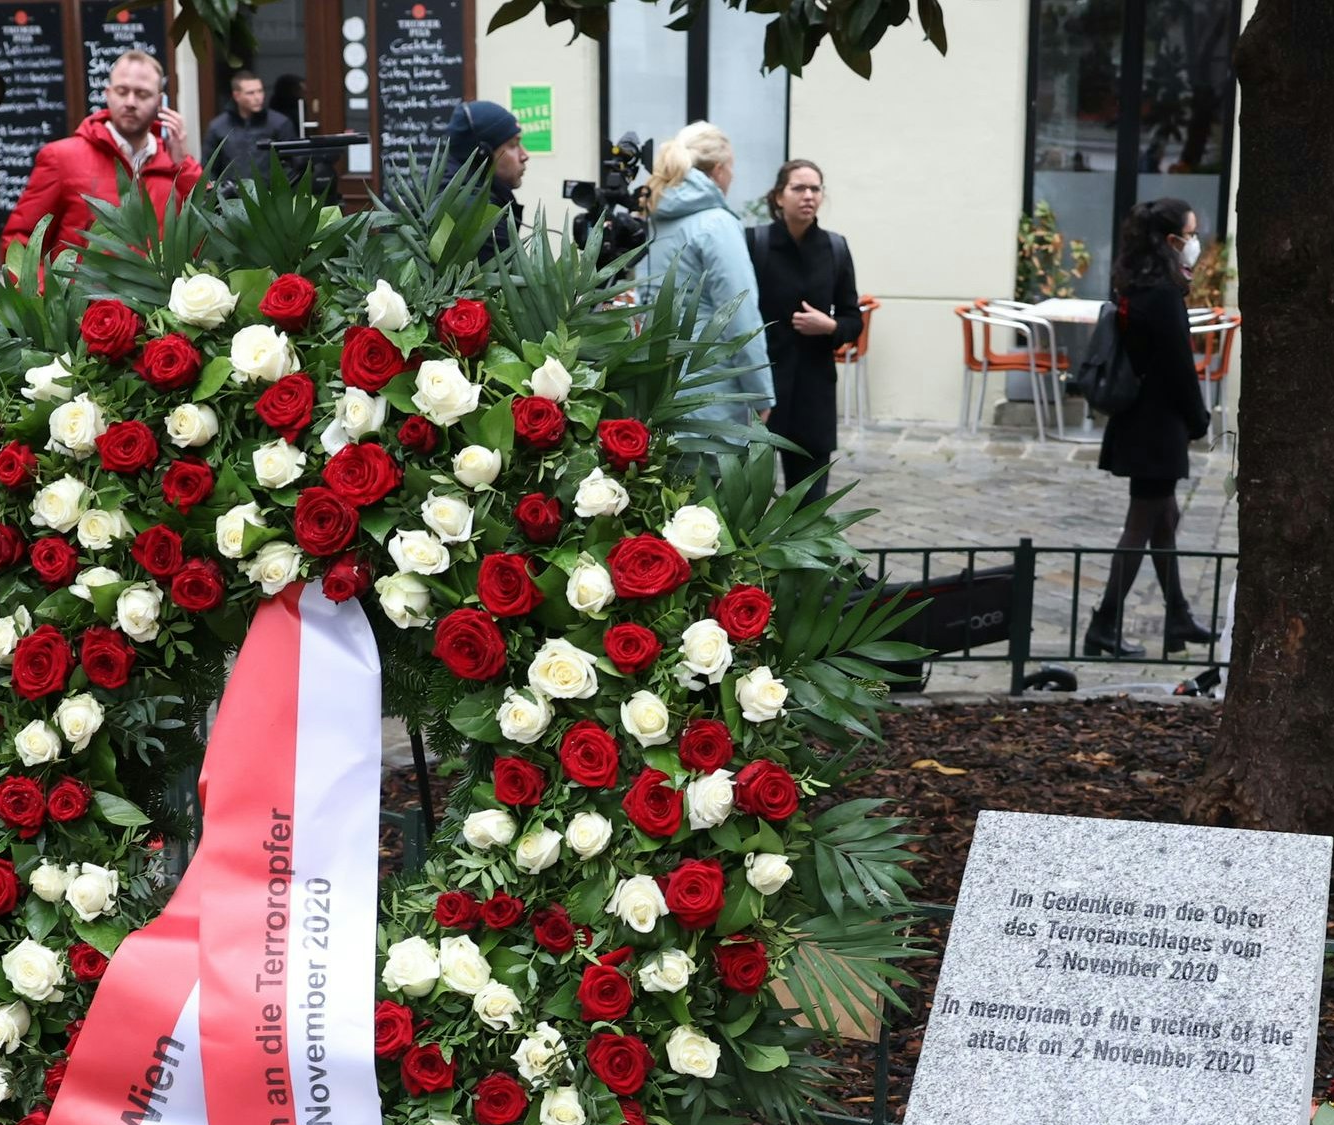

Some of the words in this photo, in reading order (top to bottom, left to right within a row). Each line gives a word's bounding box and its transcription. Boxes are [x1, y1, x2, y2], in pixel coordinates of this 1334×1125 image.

[256, 808, 296, 993] Terroropfer
[302, 878, 331, 950] 2020
[1009, 888, 1033, 909] Im
[1042, 891, 1135, 916] Gedenken
[1144, 903, 1167, 920] an
[1175, 901, 1205, 922] die
[1214, 905, 1267, 930] Opfer
[1004, 916, 1038, 938] des
[1048, 920, 1213, 955] Terroranschlages
[1223, 938, 1263, 959] vom
[1035, 949, 1053, 969] 2.
[1062, 952, 1161, 978] November
[1169, 960, 1219, 983] 2020
[256, 1004, 282, 1055] die
[941, 995, 960, 1016] In
[1080, 1009, 1100, 1029] of
[1110, 1010, 1141, 1033] the
[1151, 1019, 1222, 1040] victims
[1231, 1021, 1252, 1044] of
[1261, 1023, 1294, 1047] the
[967, 1029, 1029, 1053] attack
[1038, 1037, 1063, 1057] on
[1071, 1038, 1085, 1060] 2
[1093, 1039, 1195, 1069] November
[1204, 1049, 1256, 1076] 2020
[265, 1067, 289, 1106] an
